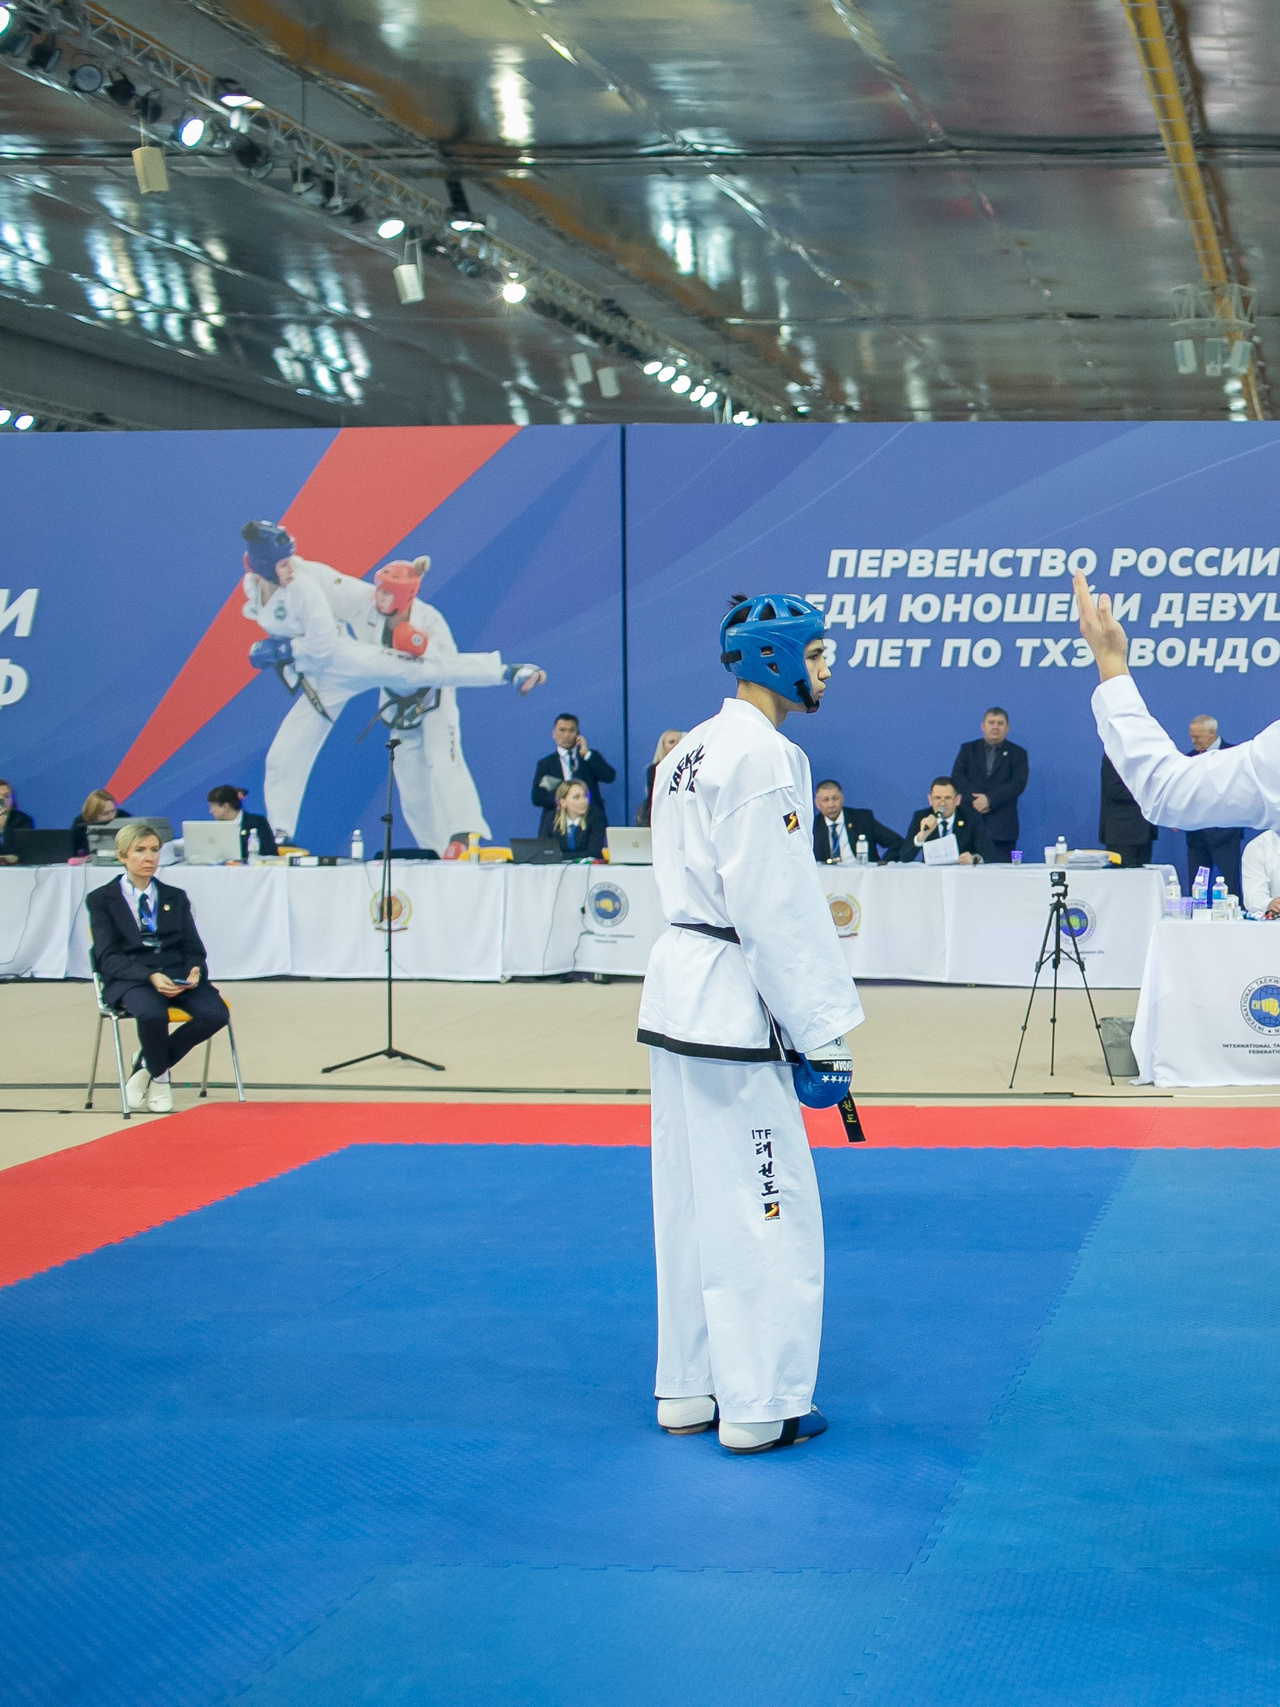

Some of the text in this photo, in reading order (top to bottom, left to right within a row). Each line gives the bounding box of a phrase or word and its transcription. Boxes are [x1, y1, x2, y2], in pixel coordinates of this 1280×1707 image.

[827, 547, 1280, 578] ПЕРВЕНСТВО РОССИИ
[804, 593, 887, 629] ЕДИ
[1112, 592, 1142, 622] И
[847, 637, 931, 668] ЛЕТ
[941, 637, 1002, 668] ПО
[751, 1128, 772, 1140] ITF
